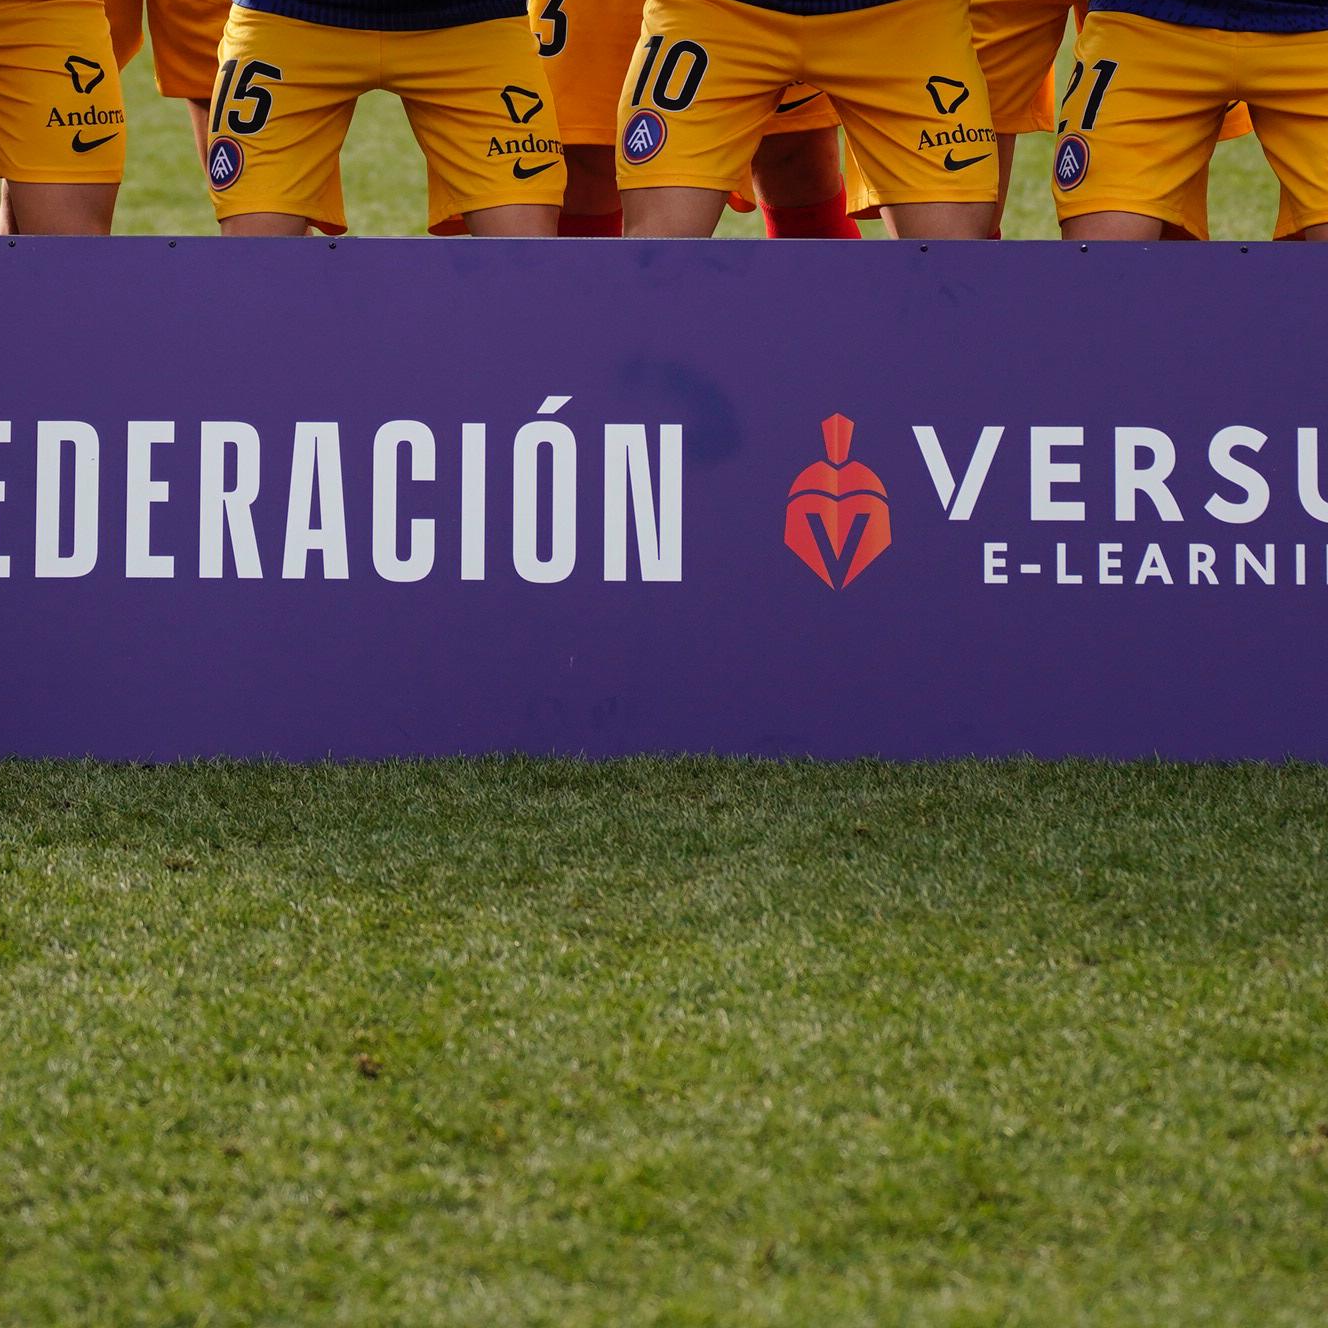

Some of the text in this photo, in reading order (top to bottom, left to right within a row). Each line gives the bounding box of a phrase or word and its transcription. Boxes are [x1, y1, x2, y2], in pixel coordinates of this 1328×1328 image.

[211, 58, 283, 135] 15
[631, 35, 710, 112] 10
[46, 104, 125, 128] Andorra
[918, 122, 996, 151] Andorra
